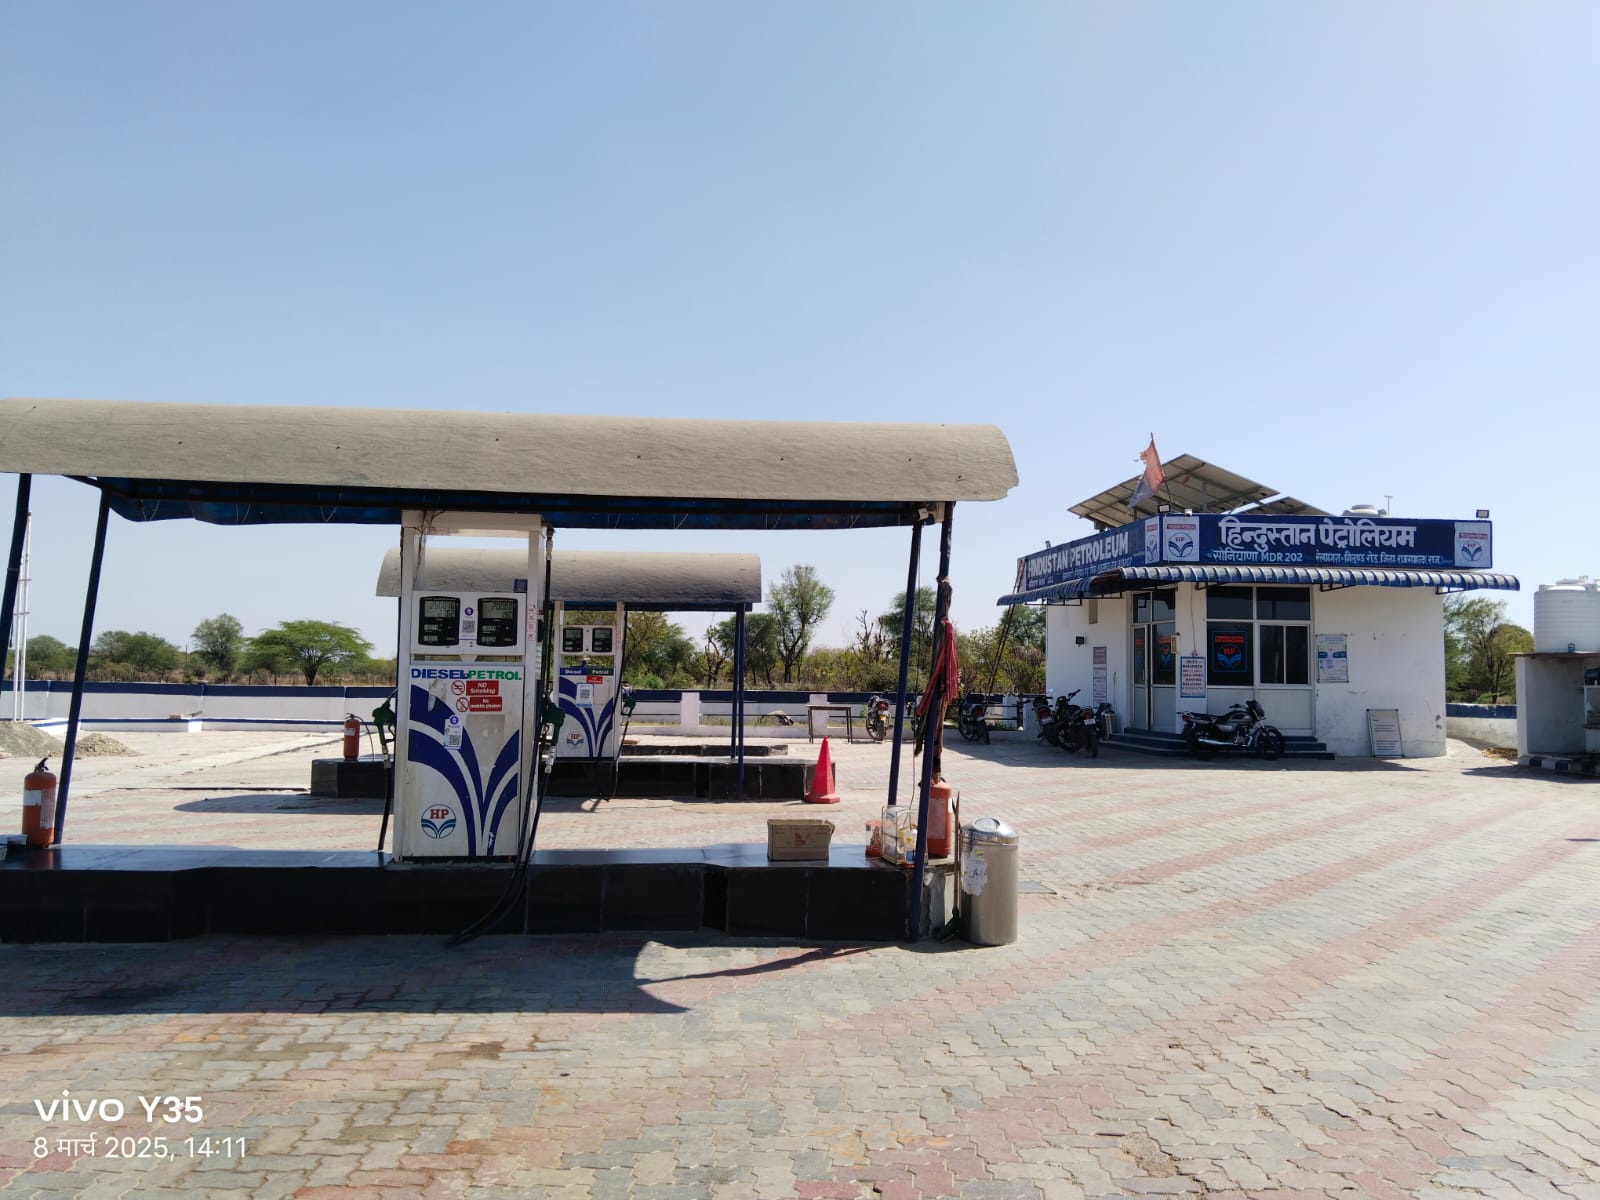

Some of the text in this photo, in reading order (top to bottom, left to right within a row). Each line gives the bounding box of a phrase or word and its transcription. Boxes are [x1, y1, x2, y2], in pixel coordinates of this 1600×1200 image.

[1218, 516, 1417, 552] हिन्दुस्तान पेट्रोलियम
[1028, 551, 1069, 578] HINDUSTAN
[1070, 531, 1129, 568] PETROLEUM
[1261, 552, 1283, 562] MDR
[1285, 552, 1303, 562] 202
[411, 668, 522, 681] DIESEL PETROL
[430, 809, 449, 819] HP
